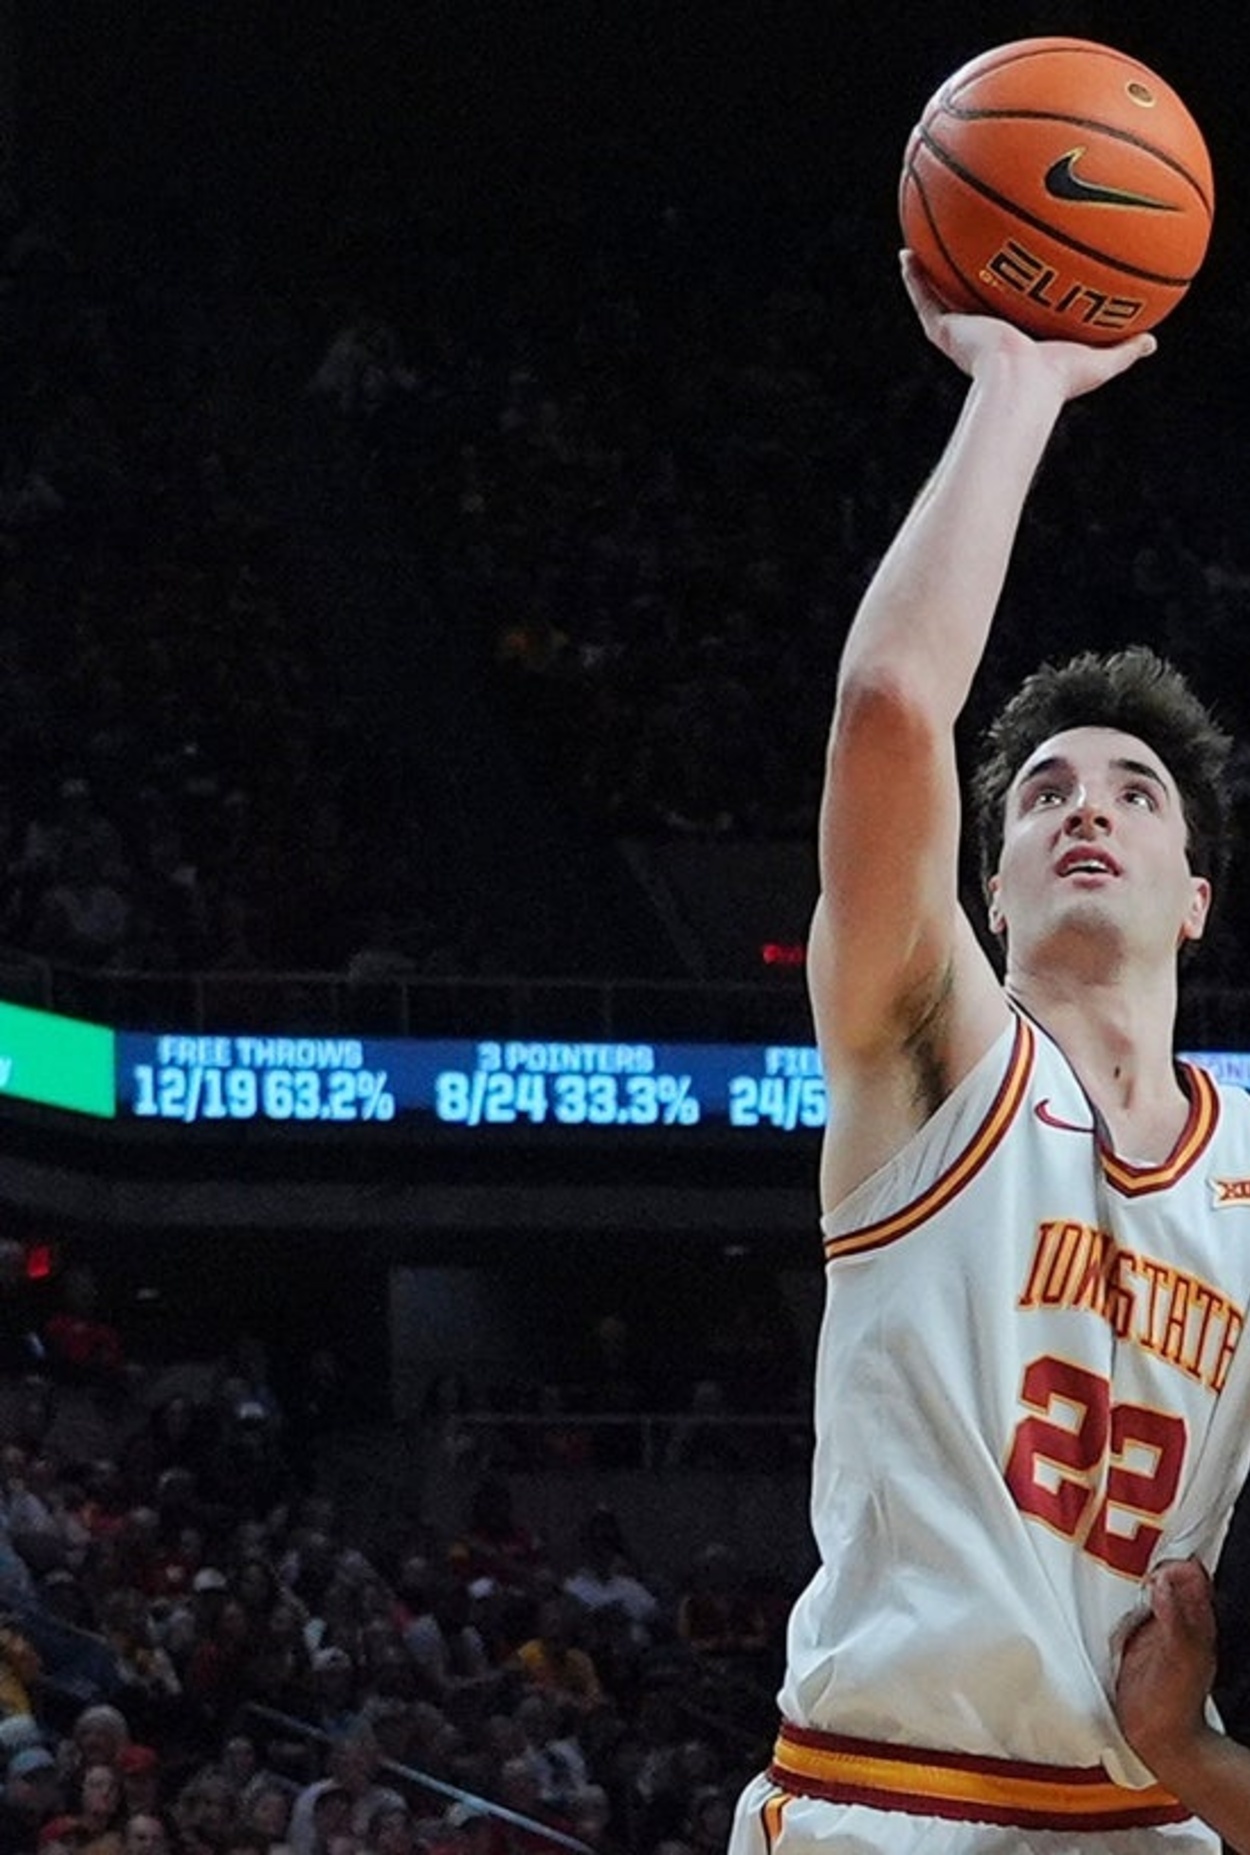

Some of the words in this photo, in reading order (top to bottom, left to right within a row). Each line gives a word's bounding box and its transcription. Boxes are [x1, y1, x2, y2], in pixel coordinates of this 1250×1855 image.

[986, 238, 1144, 330] ELITE
[158, 1035, 231, 1067] FREE
[236, 1037, 363, 1069] THROWS
[476, 1042, 501, 1071] 3
[505, 1042, 655, 1073] POINTERS
[134, 1065, 257, 1123] 12/19
[263, 1069, 395, 1121] 63.2%
[436, 1071, 547, 1126] 8/24
[554, 1074, 700, 1125] 33.3%
[728, 1076, 826, 1131] 24/5
[1004, 1354, 1190, 1584] 22
